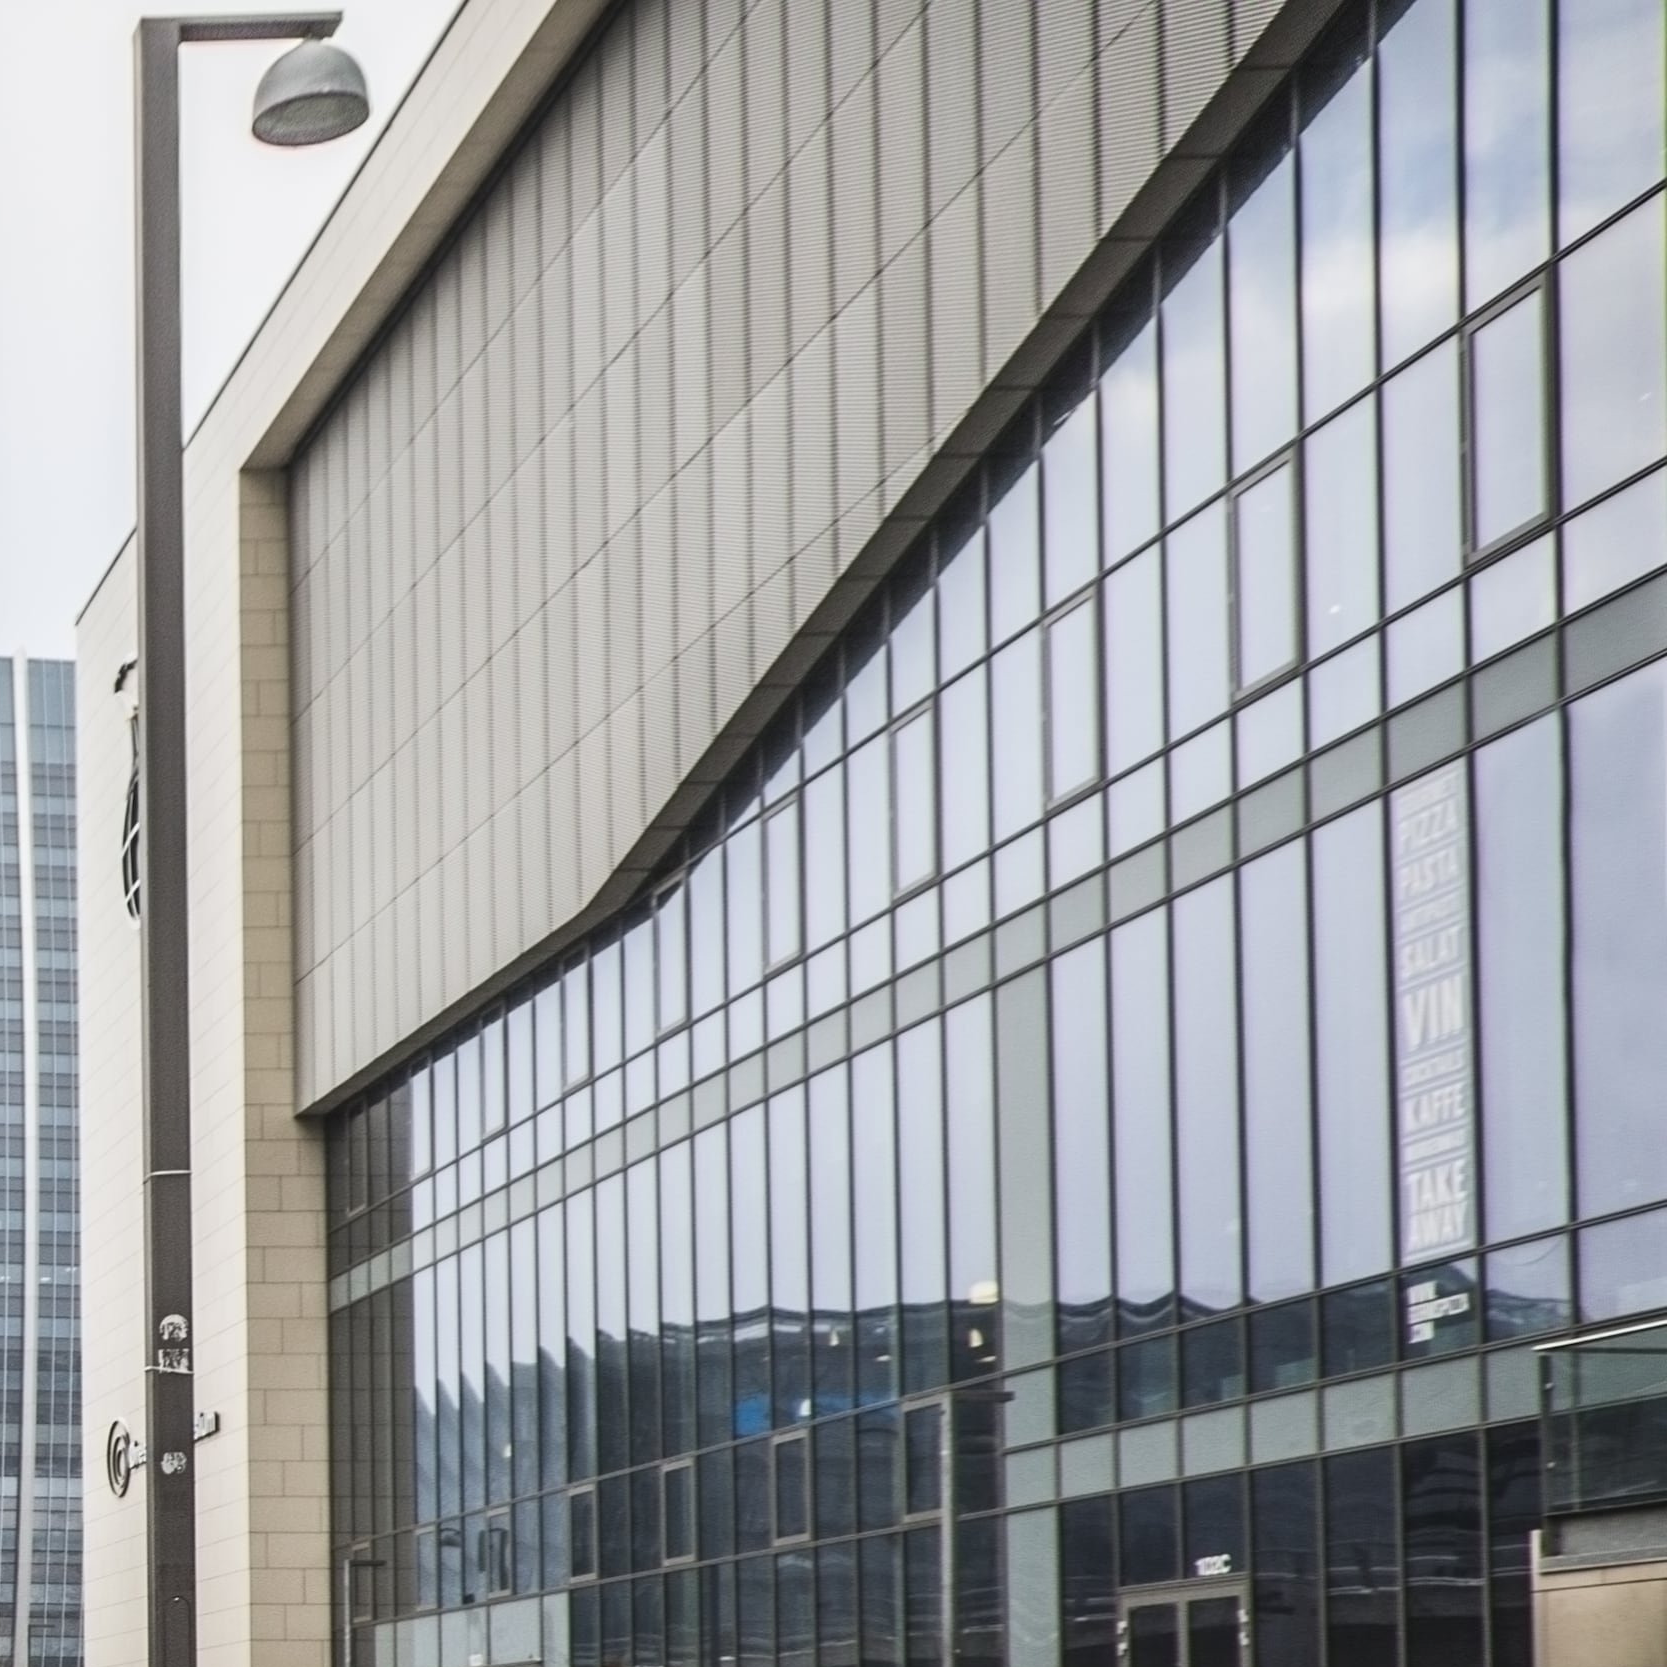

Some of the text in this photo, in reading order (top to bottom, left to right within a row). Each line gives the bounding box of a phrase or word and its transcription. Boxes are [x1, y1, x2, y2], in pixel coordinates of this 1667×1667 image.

[1400, 799, 1459, 851] PIZZA
[1400, 846, 1460, 897] PASTA
[1402, 927, 1461, 978] SALAT
[1403, 975, 1464, 1049] VIN
[1404, 1084, 1465, 1132] KAFFE
[1407, 1159, 1466, 1211] TAKE
[1408, 1203, 1465, 1248] AWAY
